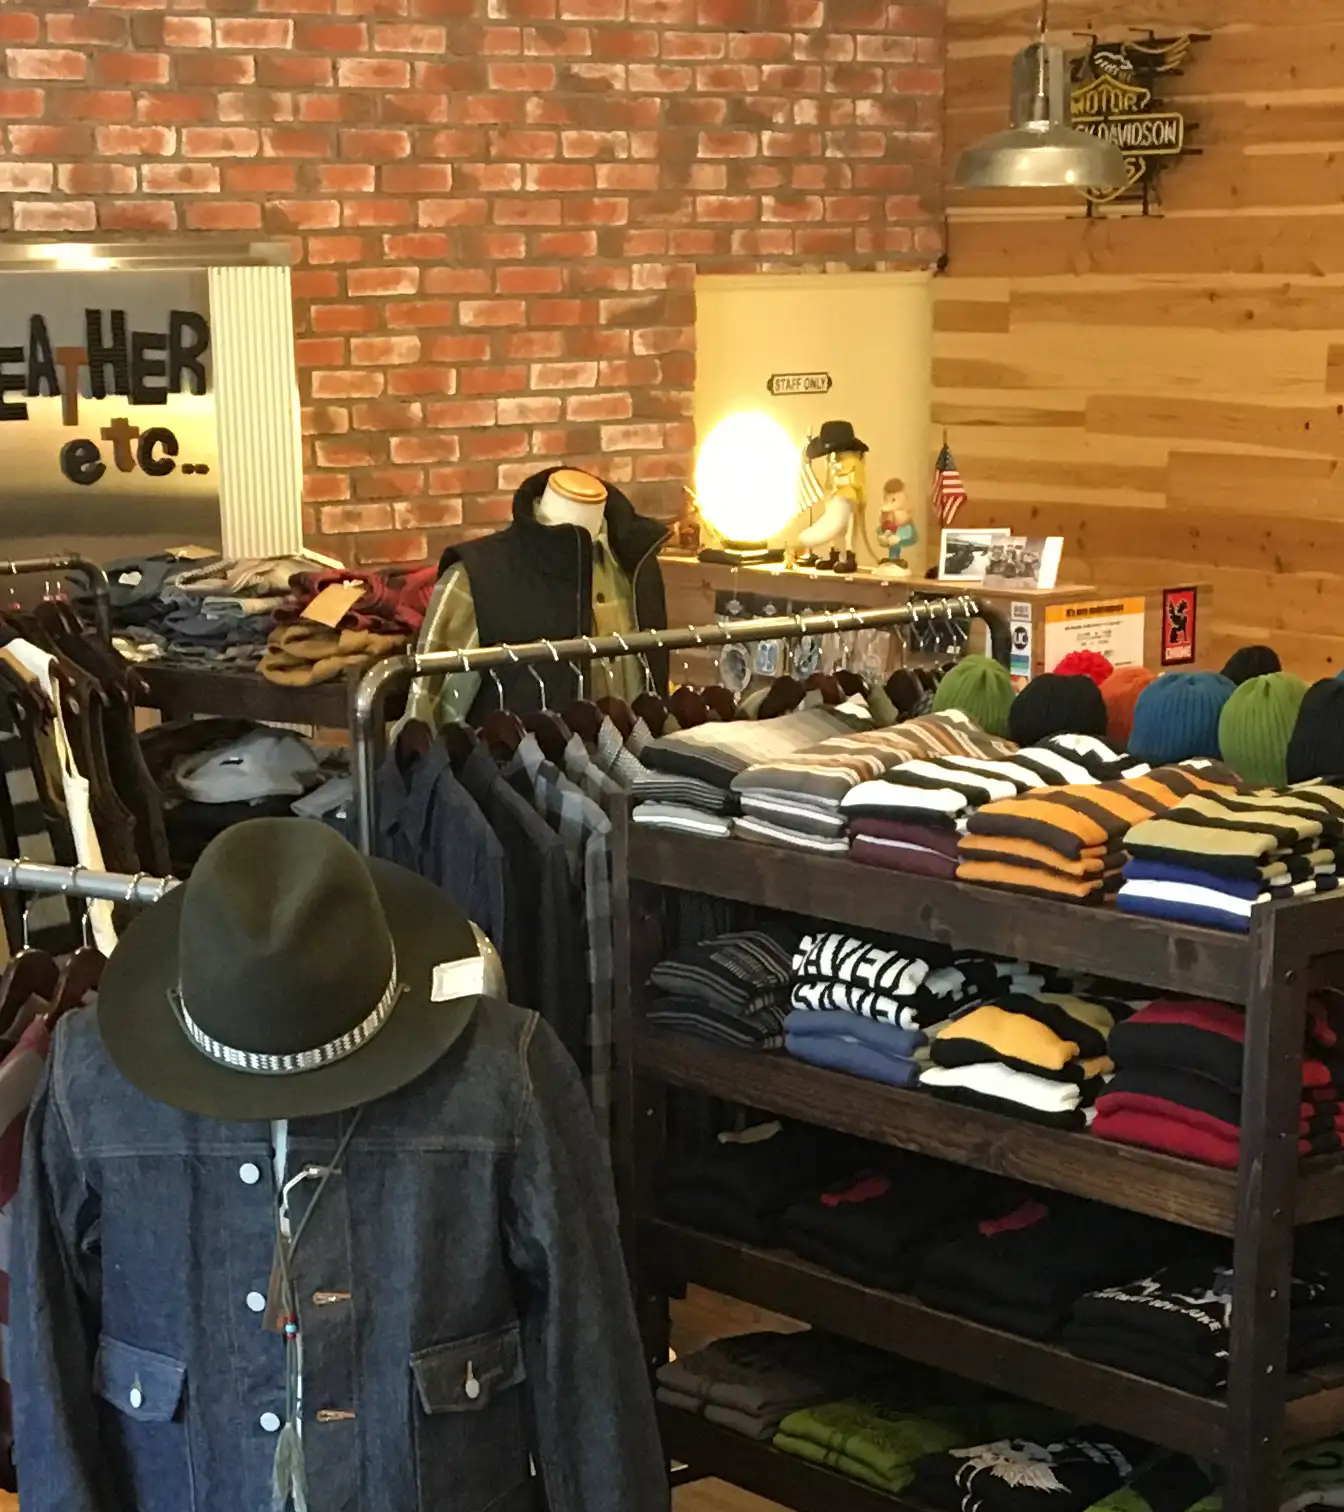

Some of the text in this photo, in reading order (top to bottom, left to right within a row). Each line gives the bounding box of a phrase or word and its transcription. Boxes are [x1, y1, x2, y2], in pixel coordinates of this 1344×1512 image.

[1071, 83, 1139, 115] MOTOR
[1076, 119, 1178, 147] DAVIDSON
[775, 377, 827, 392] STAFF ONLY
